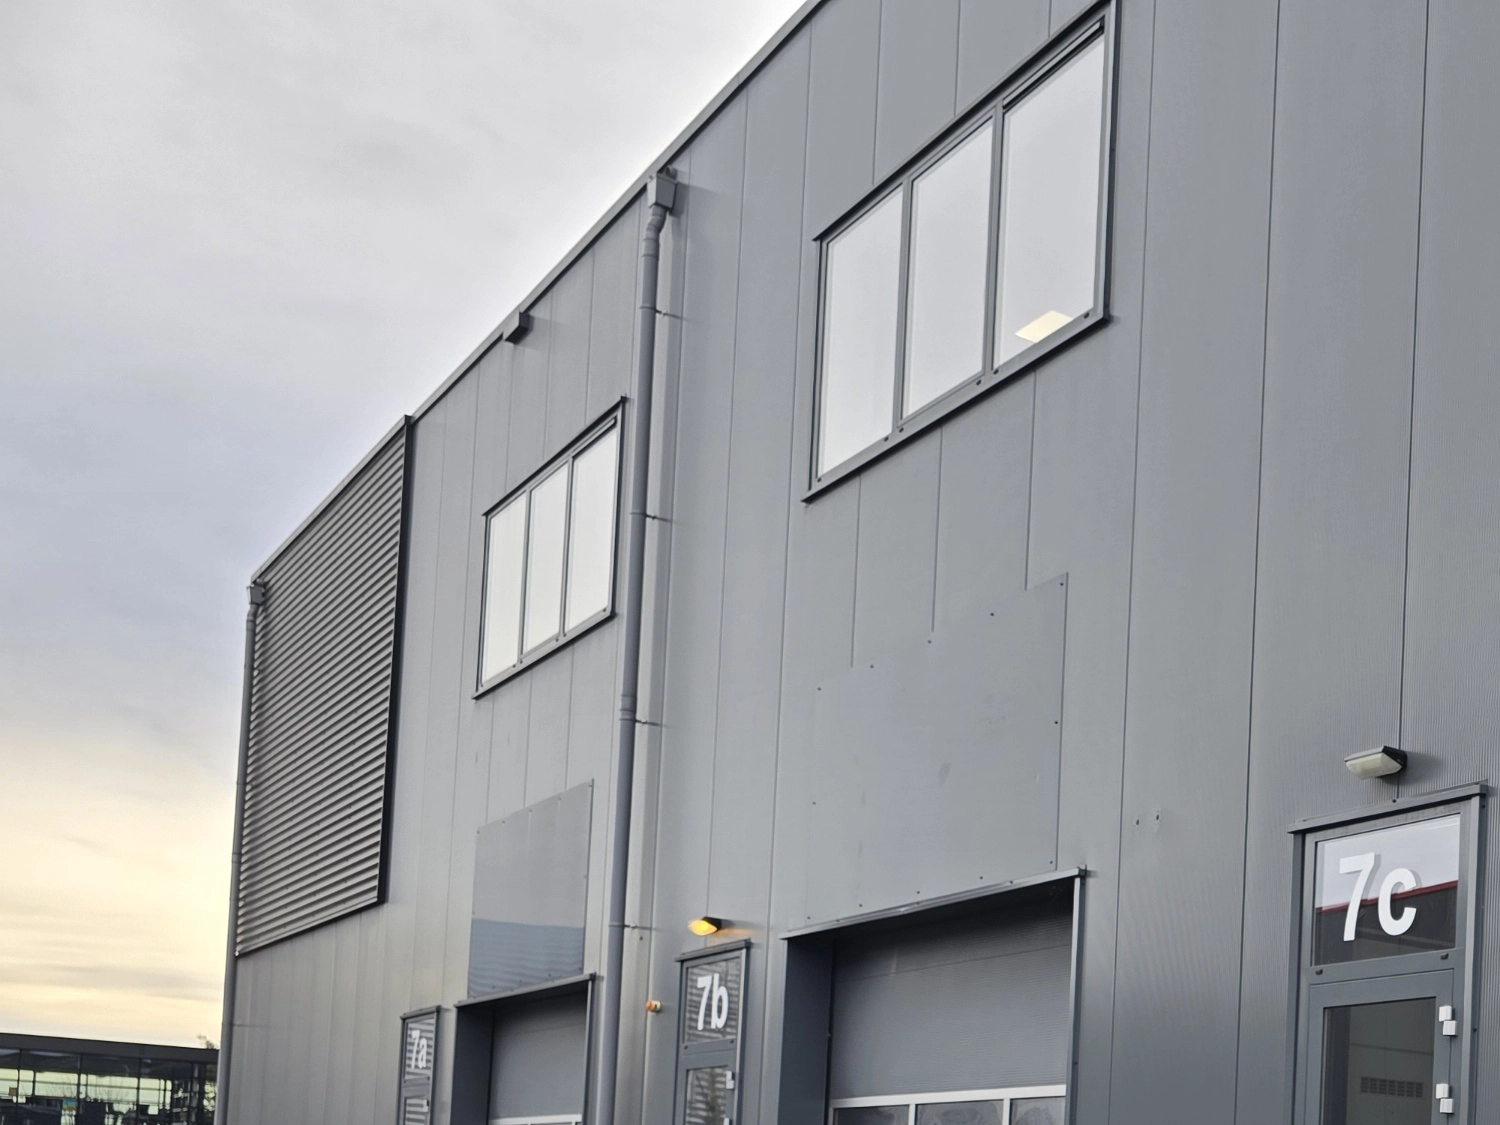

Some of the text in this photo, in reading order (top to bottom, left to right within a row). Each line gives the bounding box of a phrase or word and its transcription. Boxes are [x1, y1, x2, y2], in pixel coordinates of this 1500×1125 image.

[1339, 852, 1417, 942] 7c
[697, 973, 729, 1031] 7b
[411, 1029, 428, 1069] 7a
